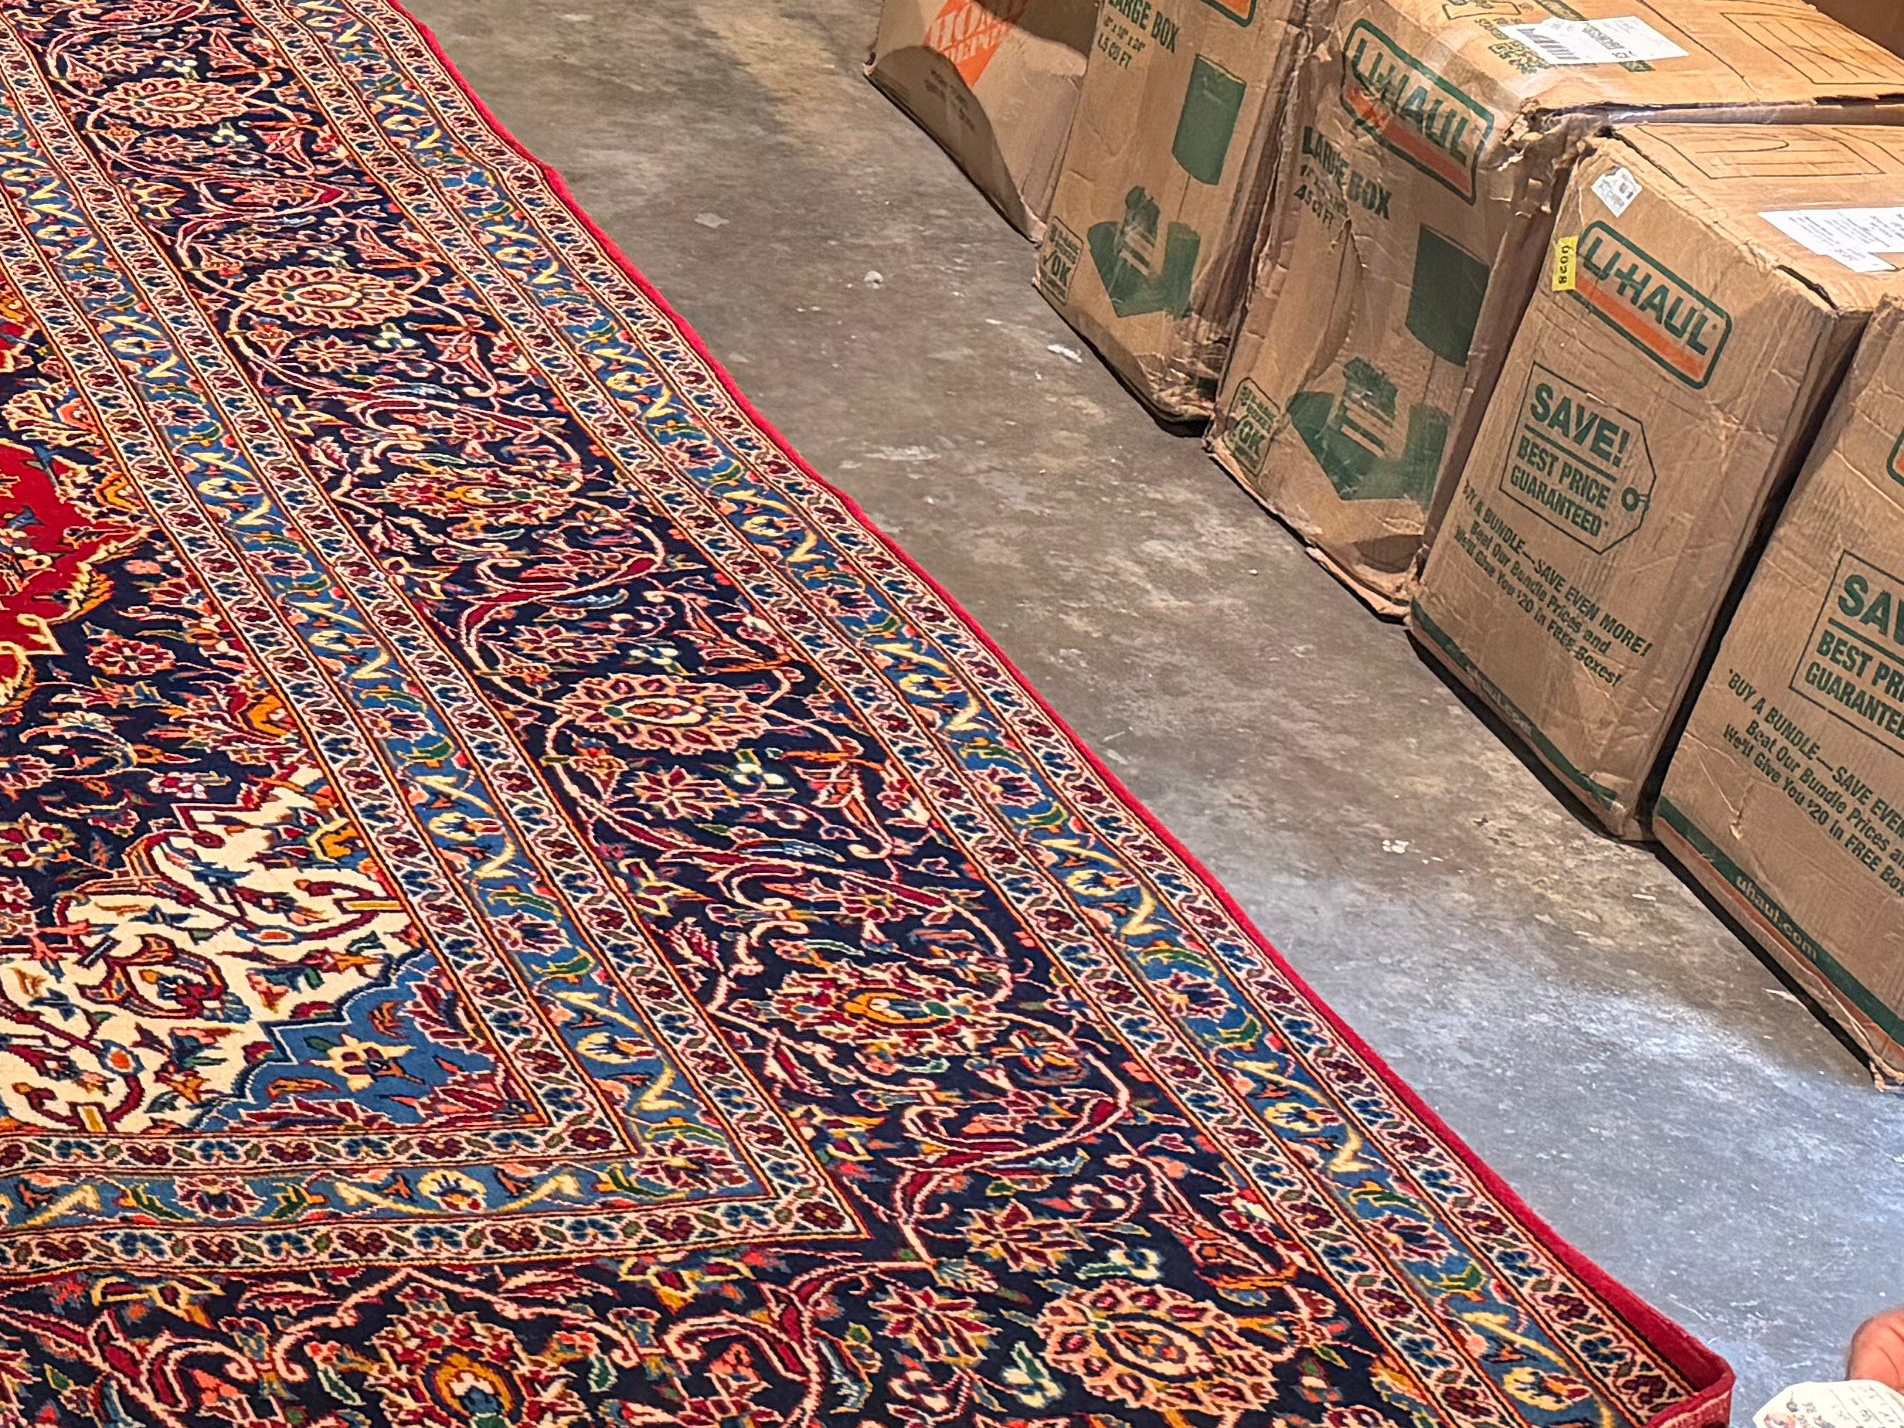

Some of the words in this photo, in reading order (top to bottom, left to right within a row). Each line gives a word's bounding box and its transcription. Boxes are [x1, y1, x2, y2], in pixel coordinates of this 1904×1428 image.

[1150, 9, 1182, 55] BOX
[1346, 170, 1393, 221] BOX
[1583, 235, 1709, 356] U-HAUL
[1530, 382, 1630, 468] SAVE!
[1517, 434, 1560, 477] BEST
[1558, 461, 1612, 510] PRICE
[1469, 520, 1494, 551] Beat
[1492, 548, 1512, 569] Our
[1509, 562, 1547, 604] Bundle
[1546, 597, 1583, 634] Prices
[1582, 630, 1612, 656] and
[1474, 549, 1496, 579] Give
[1495, 572, 1516, 597] You
[1545, 620, 1578, 653] FREE
[1574, 644, 1625, 688] Boxes!
[1565, 586, 1601, 622] EVEN
[1599, 612, 1654, 658] MORE!
[1816, 628, 1874, 679] BEST
[1751, 697, 1767, 716] A
[1721, 722, 1755, 759] We'll
[1753, 751, 1780, 784] Give
[1782, 776, 1806, 807] You
[1806, 798, 1831, 827] $20
[1844, 833, 1883, 873] FREE
[1744, 719, 1778, 754] Beat
[1775, 745, 1801, 773] Our
[1799, 767, 1848, 815] Bundle
[1845, 806, 1891, 853] Prices
[1734, 873, 1821, 962] uhaul.com
